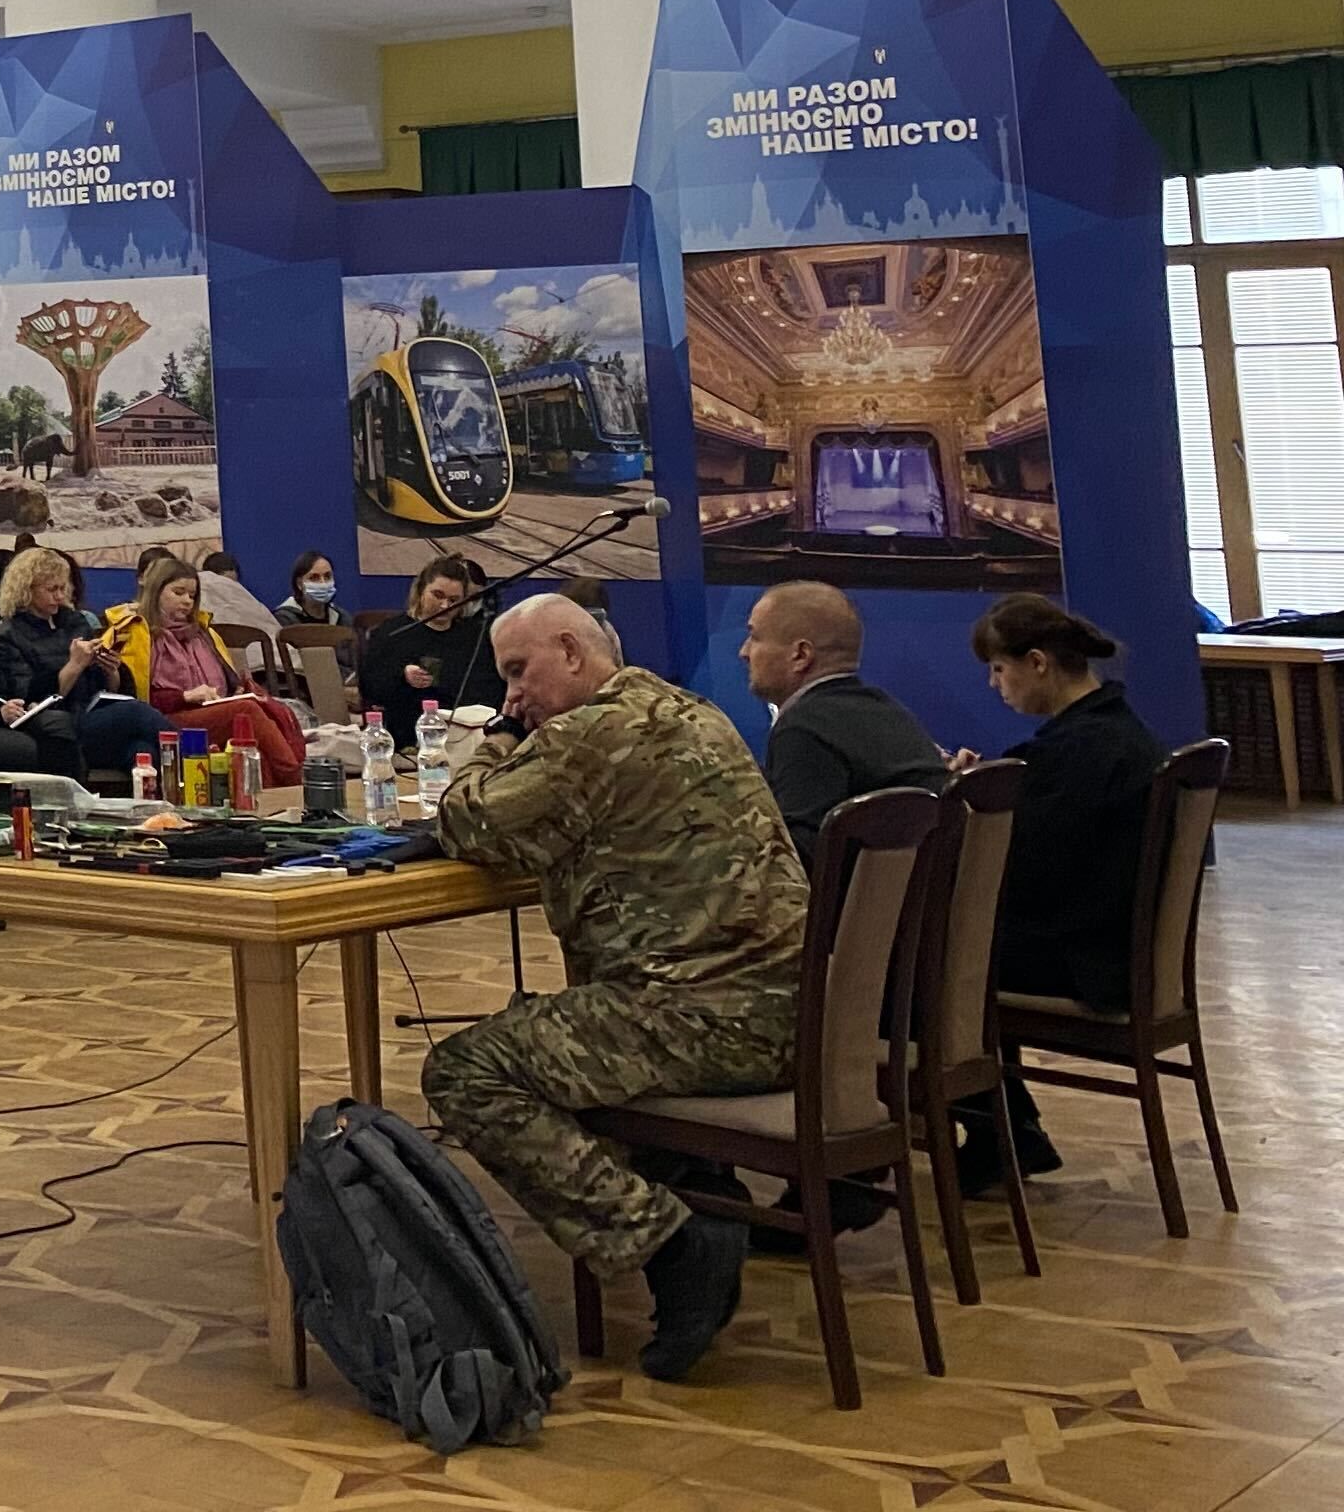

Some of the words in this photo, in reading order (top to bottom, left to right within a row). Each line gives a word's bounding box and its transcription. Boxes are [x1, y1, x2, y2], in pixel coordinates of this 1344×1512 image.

[732, 89, 778, 113] МИ
[788, 77, 897, 107] РАЗОМ
[706, 102, 883, 139] ЗМІНЮЄМО
[762, 129, 854, 156] НАШЕ
[862, 118, 978, 148] МІСТО!
[8, 152, 39, 172] МИ
[46, 145, 120, 168] РАЗОМ
[27, 186, 90, 208] НАШЕ
[96, 180, 175, 203] МІСТО!
